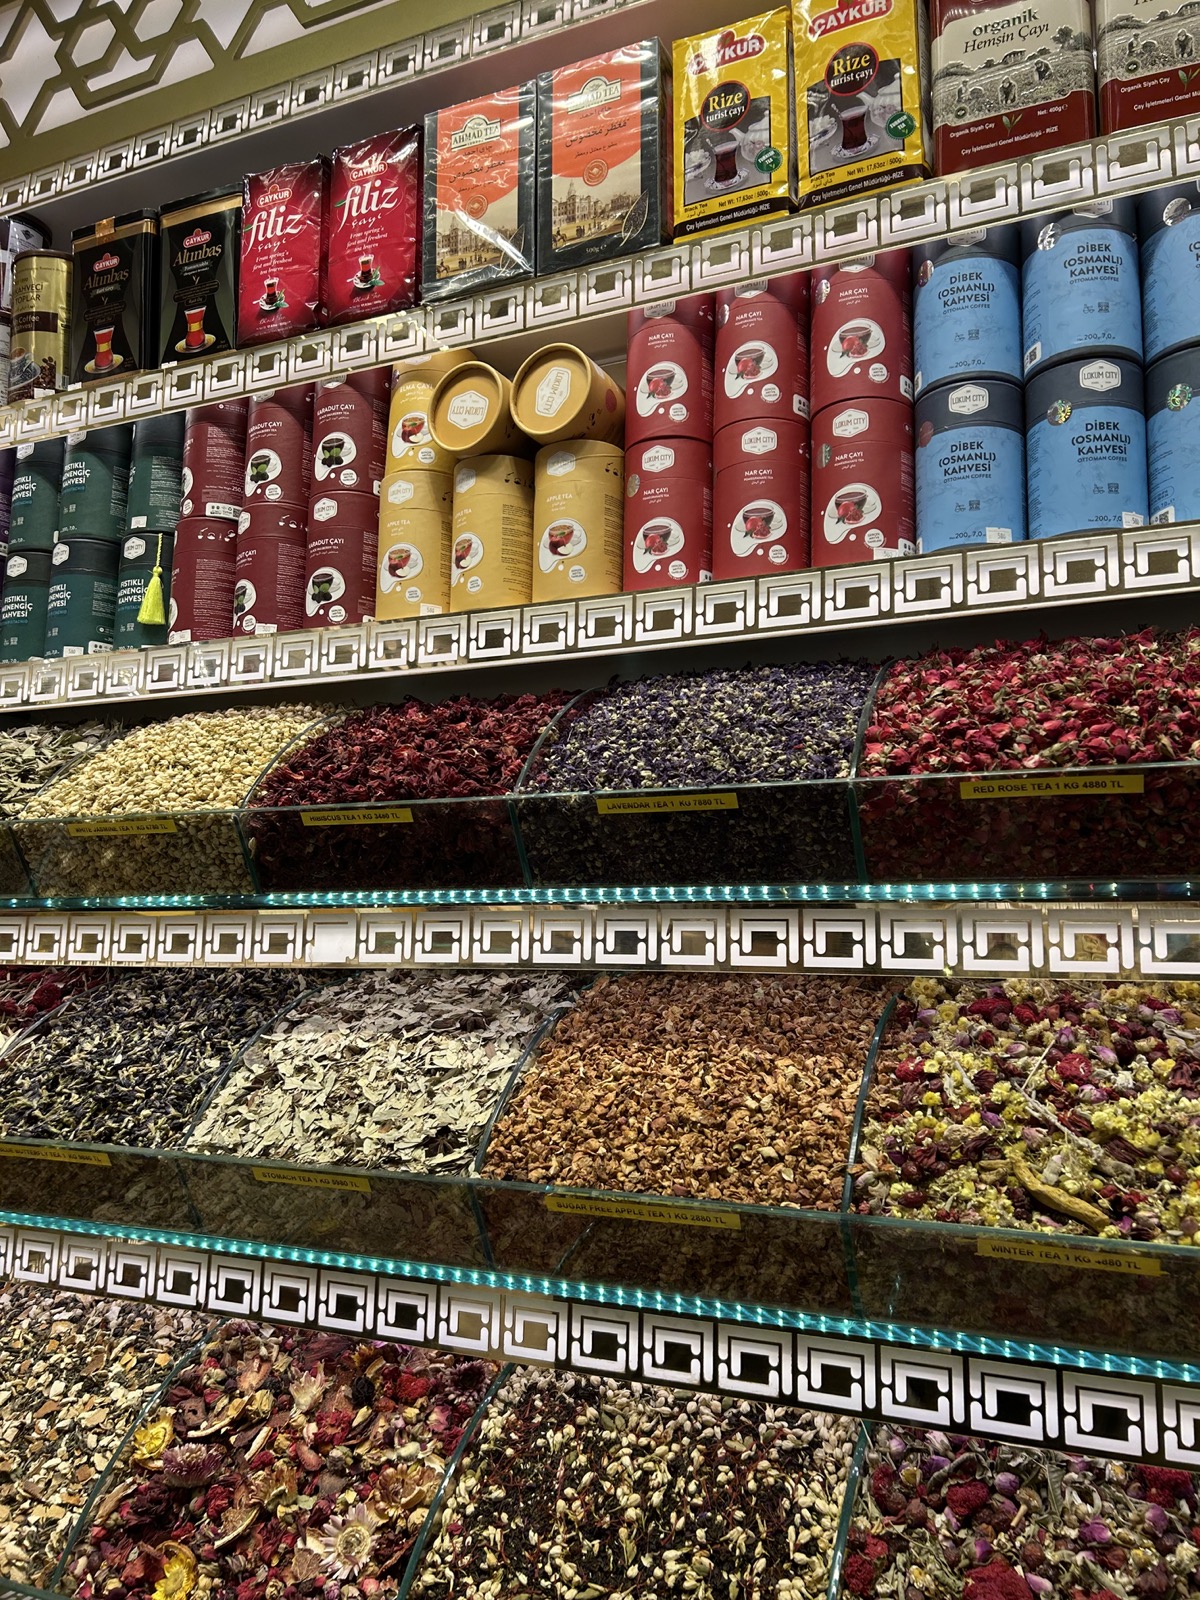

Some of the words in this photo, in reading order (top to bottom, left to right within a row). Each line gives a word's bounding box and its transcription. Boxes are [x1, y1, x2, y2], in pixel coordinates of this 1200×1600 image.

[972, 8, 1038, 37] organik
[964, 29, 1014, 53] Hemşin
[1018, 23, 1050, 42] Çayı
[833, 53, 871, 76] Rize
[830, 72, 854, 87] turist
[856, 68, 873, 82] çayı
[1121, 83, 1142, 93] Organik
[1143, 80, 1159, 88] Siyah
[708, 91, 743, 112] Rize
[706, 110, 729, 123] turist
[729, 105, 745, 118] çayı
[889, 115, 908, 128] TURKISH
[453, 130, 482, 146] AHMAD
[484, 126, 500, 137] TEA
[949, 129, 970, 138] Organik
[970, 125, 985, 133] Siyah
[985, 122, 996, 130] Çay
[757, 150, 776, 163] TURKISH
[846, 169, 856, 177] Net
[259, 190, 290, 206] ÇAYKUR
[811, 195, 821, 203] Çay
[848, 183, 863, 192] Genel
[336, 179, 398, 234] filiz
[719, 213, 733, 222] Genel
[243, 205, 303, 258] filiz
[1077, 241, 1111, 254] DİBEK
[173, 244, 222, 267] Altınbaş
[1063, 255, 1123, 269] (OSMANLI)
[1070, 264, 1119, 277] KAHVESİ
[84, 267, 129, 290] Altınbaş
[950, 271, 982, 284] DİBEK
[840, 289, 853, 297] NAR
[853, 287, 868, 296] ÇAYI
[937, 282, 995, 300] (OSMANLI)
[943, 291, 990, 308] KAHVESİ
[736, 313, 748, 321] NAR
[748, 311, 762, 319] ÇAYI
[649, 333, 661, 341] NAR
[661, 332, 674, 340] ÇAYI
[1083, 371, 1104, 380] LOKUM
[1105, 371, 1118, 379] CITY
[400, 383, 416, 392] ELMA
[551, 371, 565, 395] LOKUM
[952, 395, 971, 405] LOKUM
[972, 394, 985, 402] CITY
[340, 403, 355, 411] ÇAYI
[268, 420, 283, 429] ÇAYI
[835, 419, 853, 429] LOKUM
[853, 416, 865, 426] CITY
[1085, 420, 1120, 432] DİBEK
[1071, 432, 1131, 446] (OSMANLI)
[950, 440, 984, 453] DİBEK
[1077, 443, 1127, 456] KAHVESİ
[835, 453, 848, 462] NAR
[848, 451, 863, 459] ÇAYI
[938, 452, 996, 468] (OSMANLI)
[943, 461, 991, 477] KAHVESİ
[655, 486, 669, 495] ÇAYI
[546, 495, 561, 503] APPLE
[387, 520, 400, 528] APPLE
[121, 579, 144, 588] FISTIKLI
[4, 595, 28, 603] FISTIKLI
[2, 610, 28, 619] KAHVESİ
[973, 785, 995, 794] RED
[998, 783, 1028, 793] ROSE
[1031, 782, 1052, 791] TEA
[1063, 781, 1080, 790] KG
[1082, 780, 1108, 789] 4880
[1109, 780, 1124, 789] TL
[607, 801, 651, 810] LAVENDAR
[714, 798, 726, 806] TL
[310, 814, 342, 822] HIBISCUS
[261, 1171, 297, 1181] STOMACH
[556, 1201, 587, 1211] SUGAR
[589, 1204, 613, 1213] FREE
[615, 1206, 645, 1216] APPLE
[646, 1209, 665, 1218] TEA
[674, 1212, 688, 1220] KG
[713, 1215, 726, 1224] TL
[991, 1244, 1035, 1257] WINTER
[1038, 1250, 1061, 1261] TEA
[1074, 1254, 1091, 1264] KG
[1125, 1260, 1141, 1270] TL
